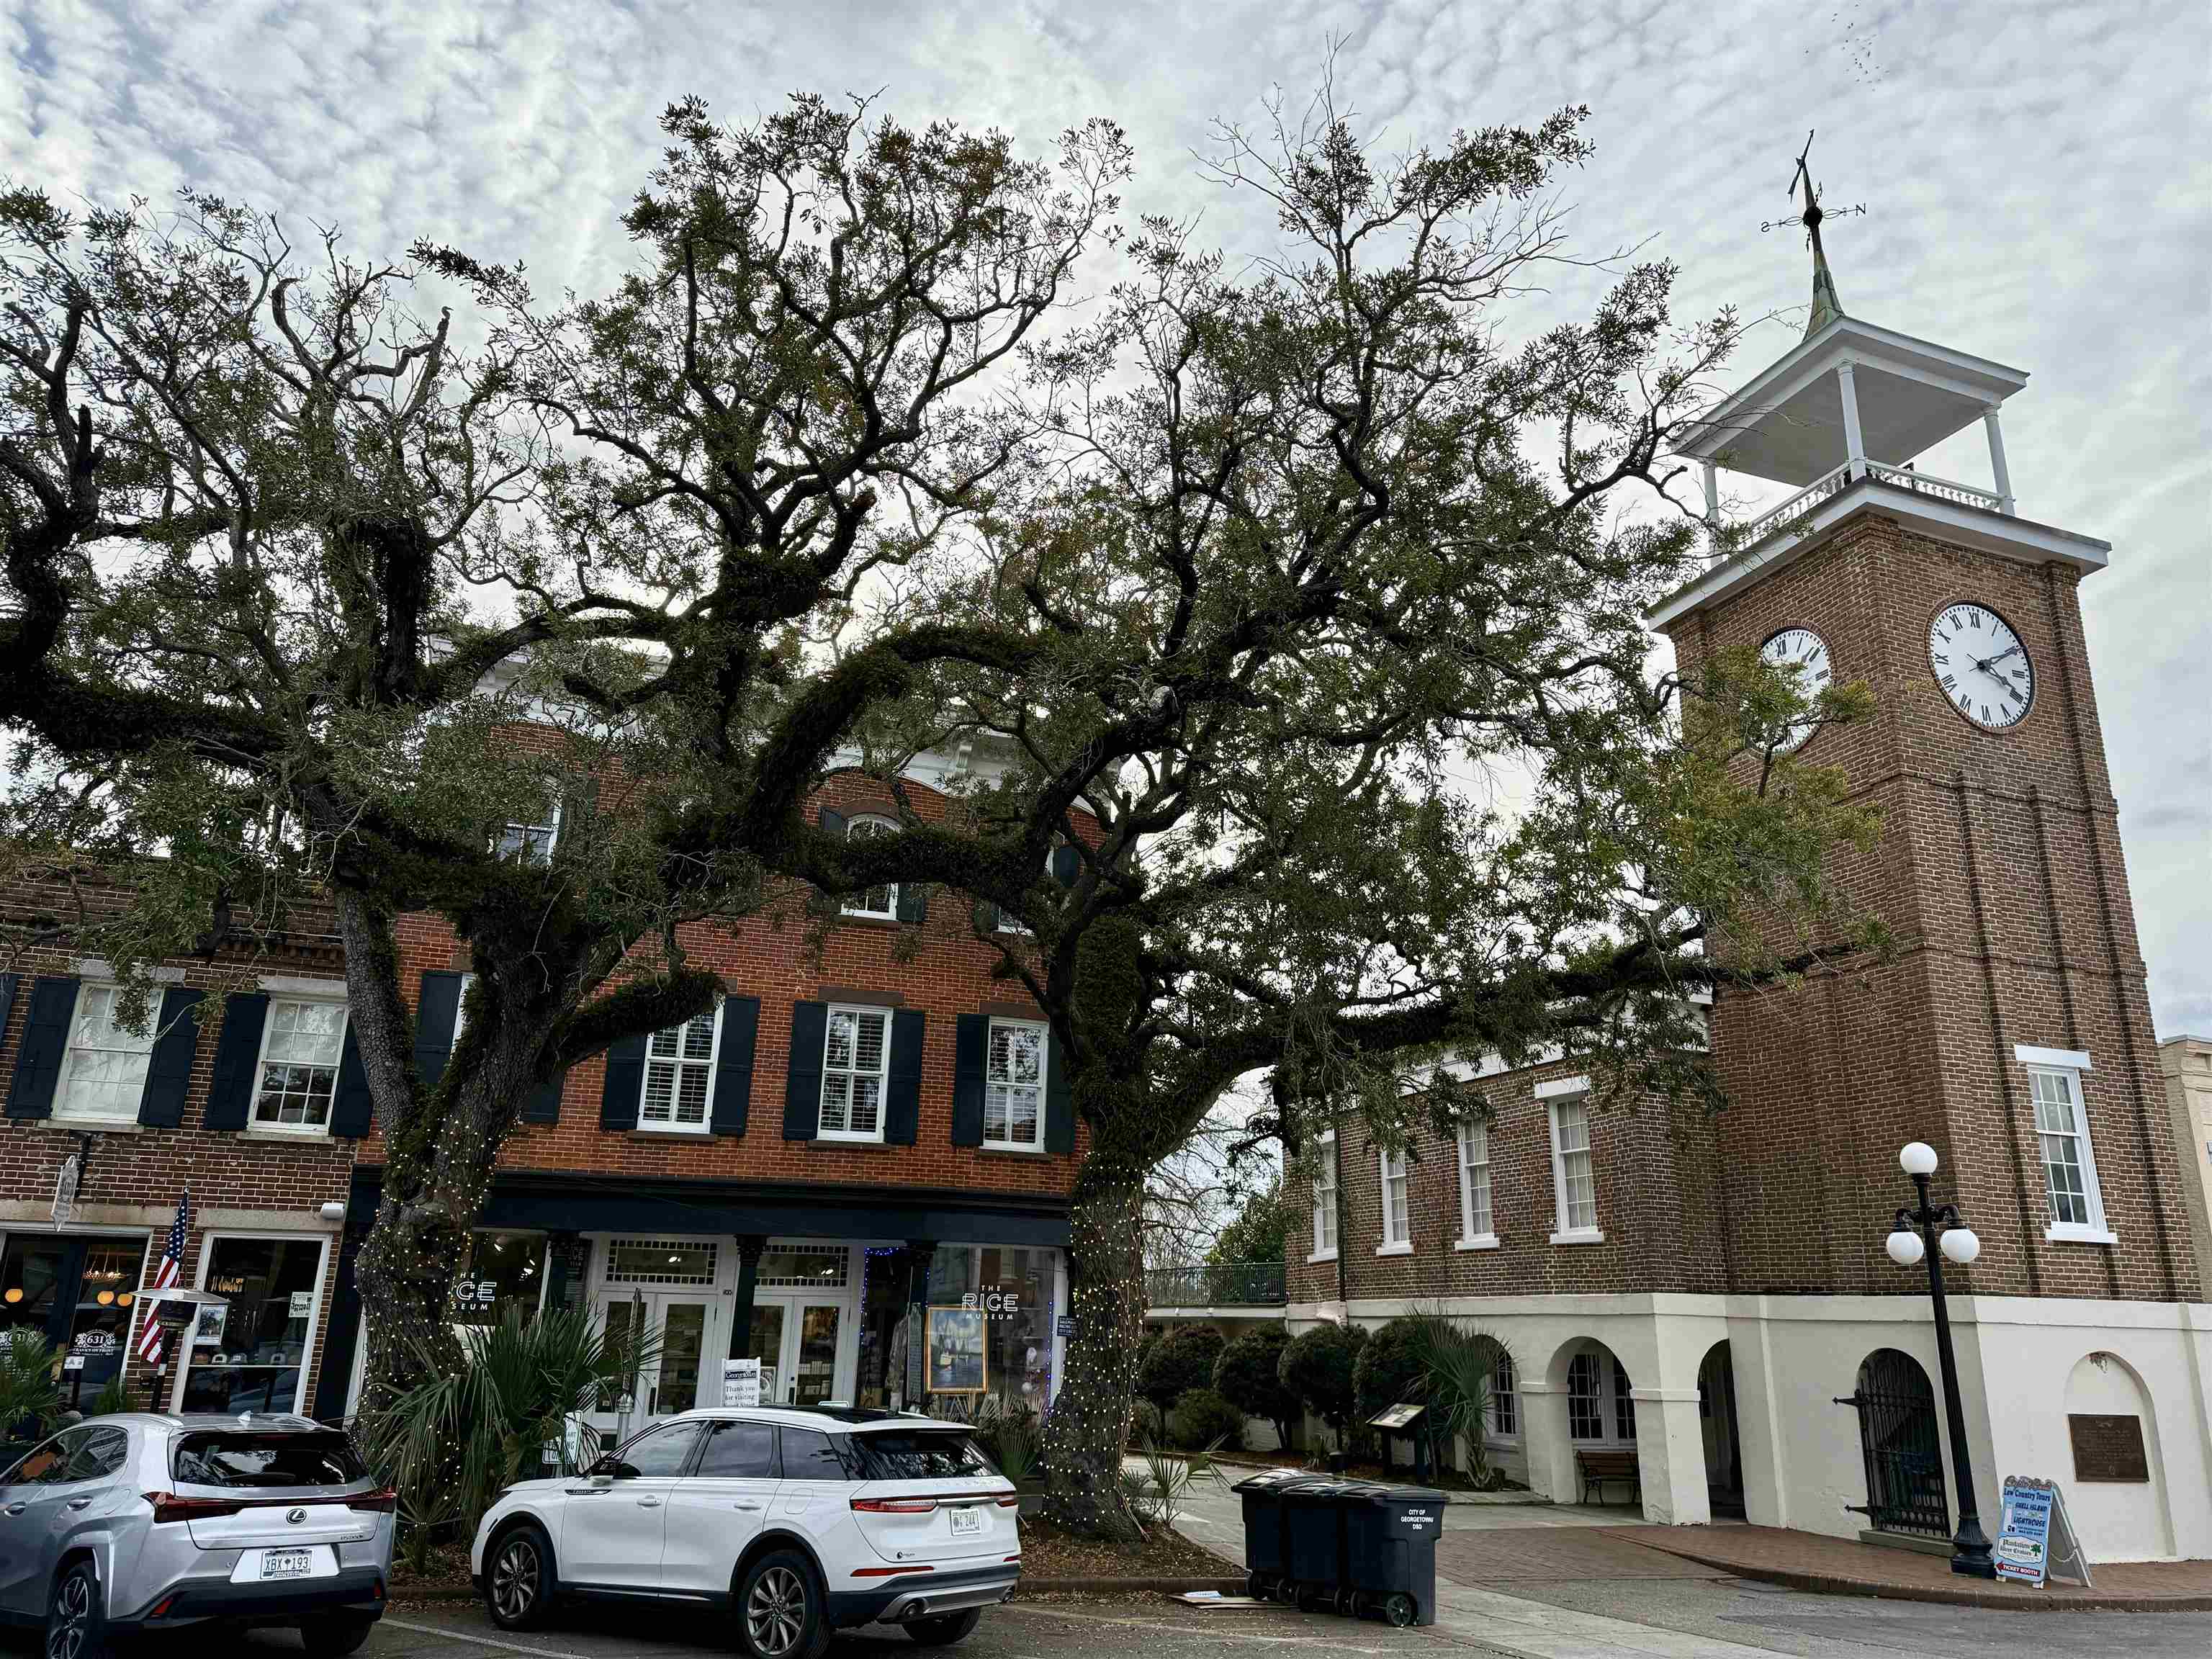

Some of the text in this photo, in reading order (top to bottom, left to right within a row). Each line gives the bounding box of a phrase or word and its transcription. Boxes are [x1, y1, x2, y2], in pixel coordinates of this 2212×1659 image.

[456, 1281, 497, 1302] CE
[961, 1293, 1019, 1312] RICE
[86, 1335, 104, 1344] 631
[2015, 1490, 2035, 1501] Country
[2036, 1492, 2051, 1501] Tours
[2013, 1516, 2046, 1527] LIGHTHOUSE
[2003, 1539, 2031, 1549] Plantation
[265, 1556, 309, 1571] XBX 193
[2020, 1567, 2038, 1575] BOOTH
